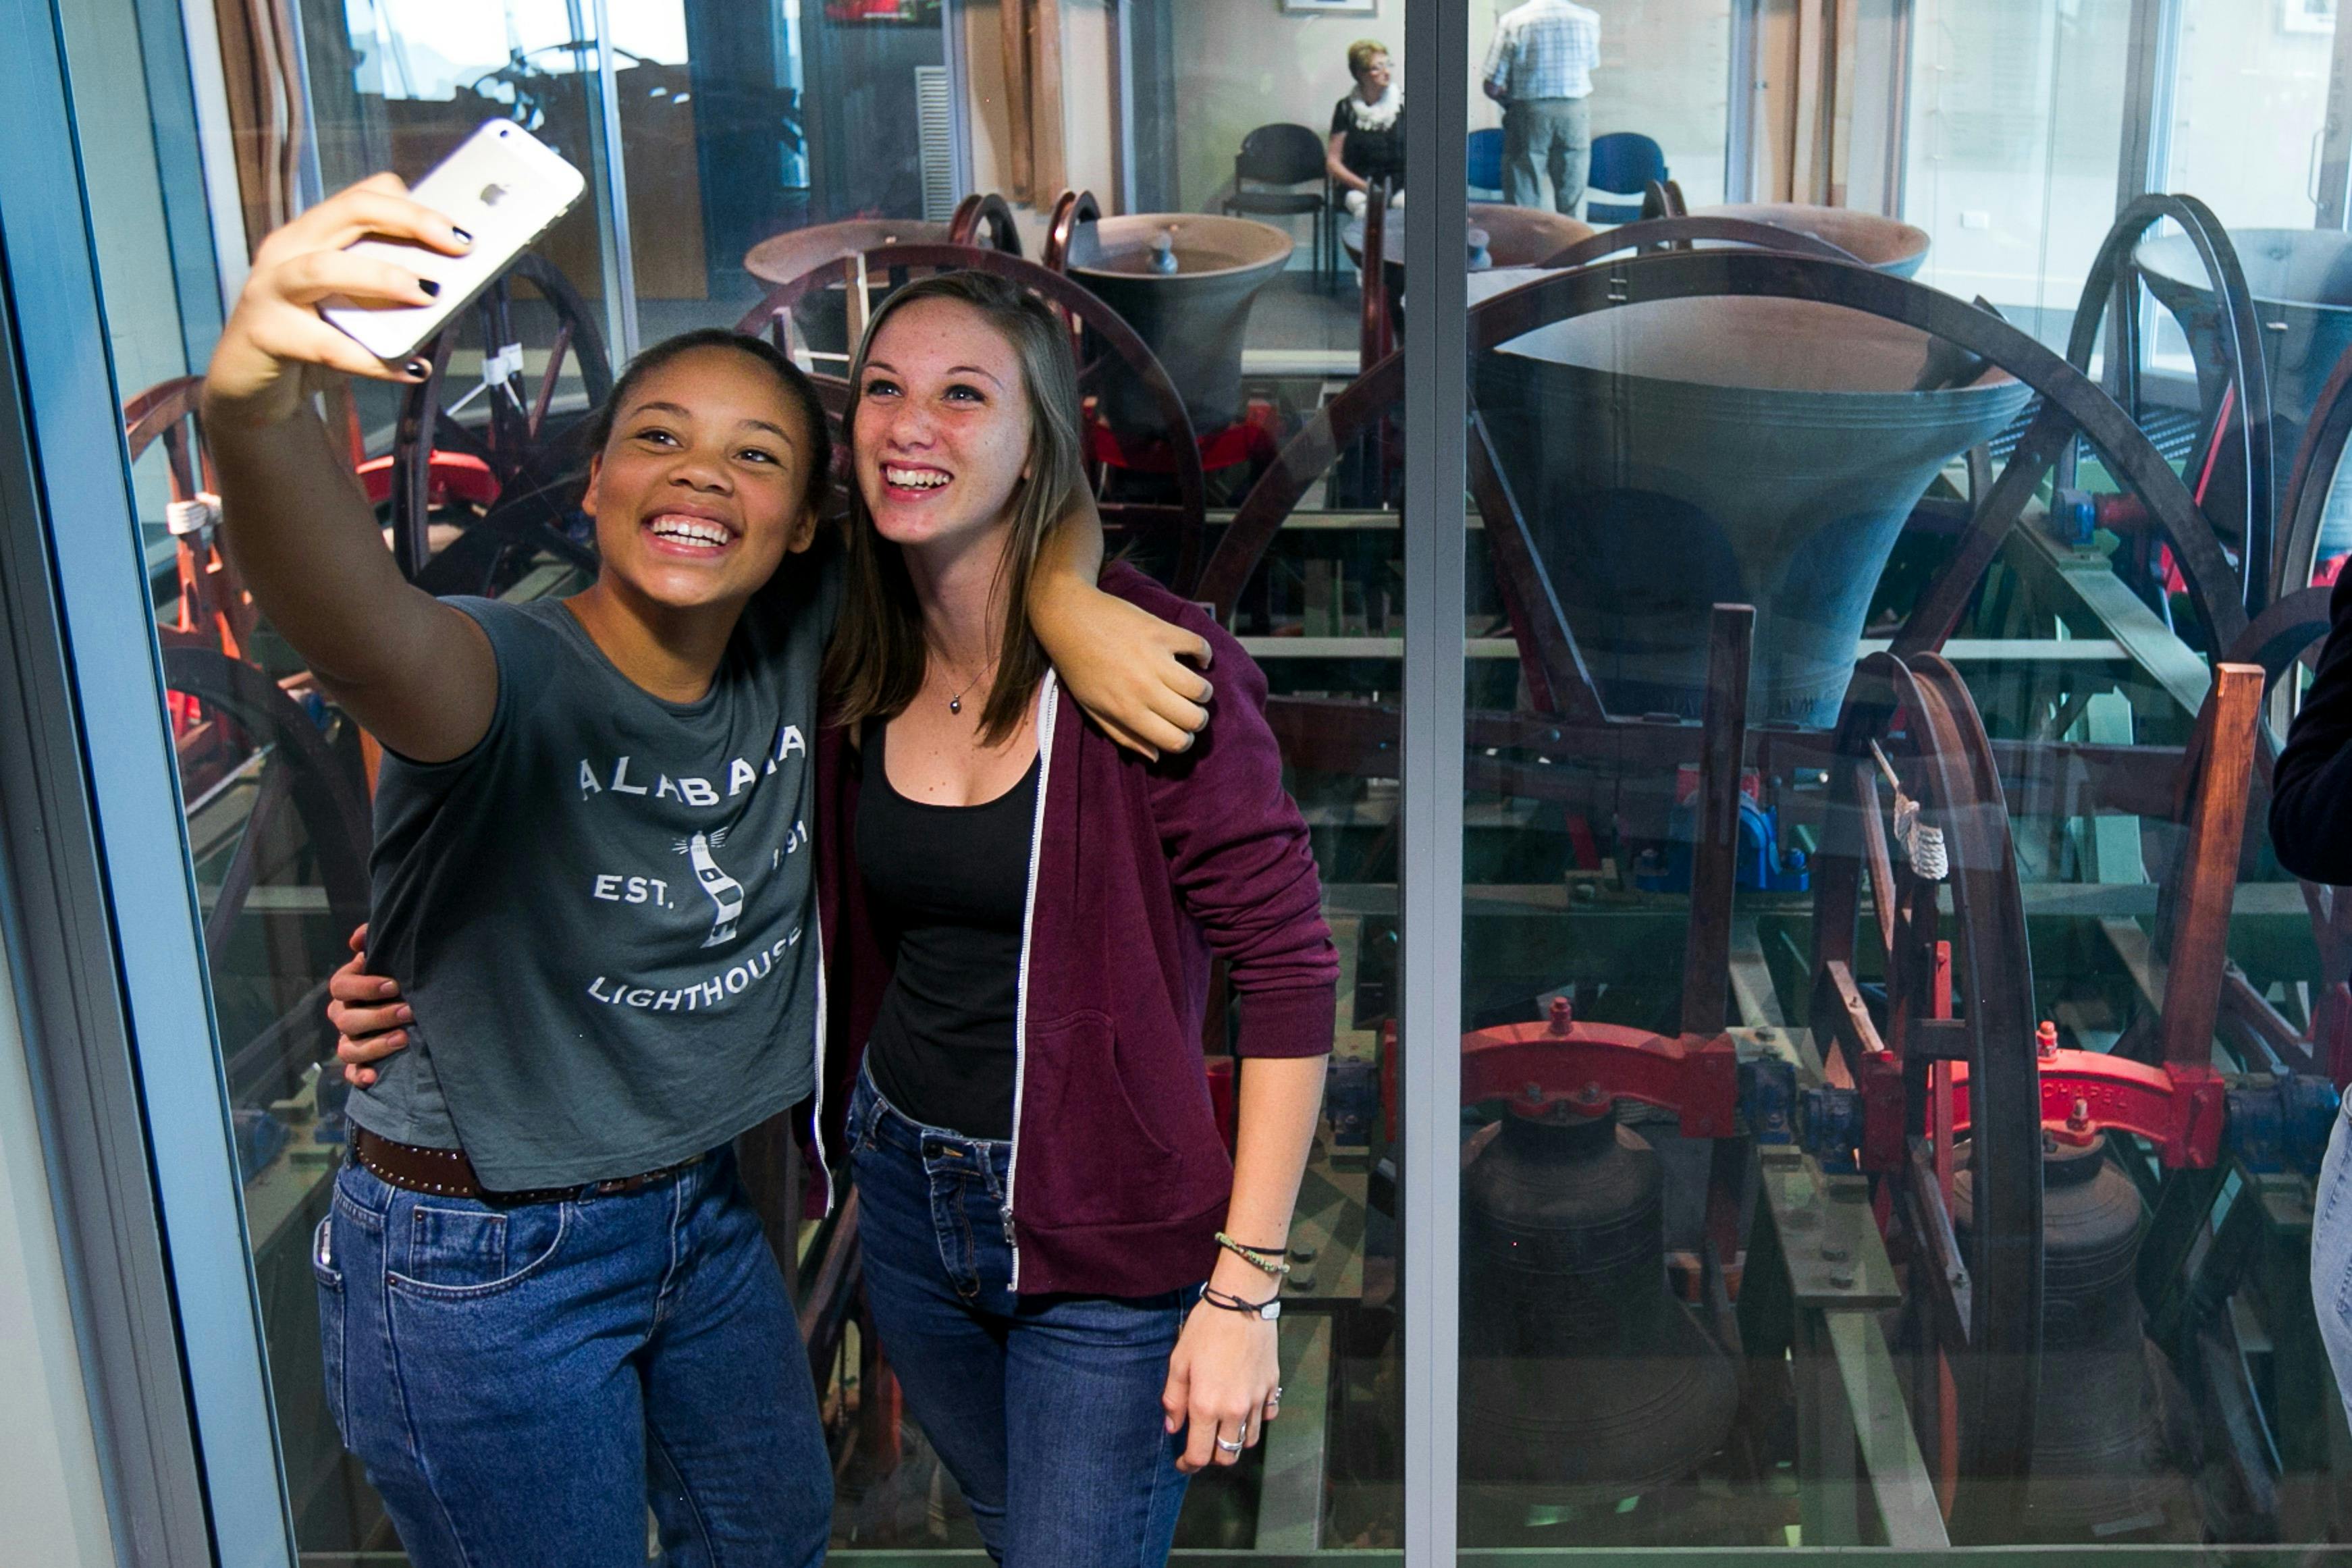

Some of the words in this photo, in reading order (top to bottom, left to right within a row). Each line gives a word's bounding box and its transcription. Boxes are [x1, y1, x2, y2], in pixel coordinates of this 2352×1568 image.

[580, 724, 806, 806] ALABAA
[594, 874, 674, 909] EST.
[772, 820, 808, 870] 191
